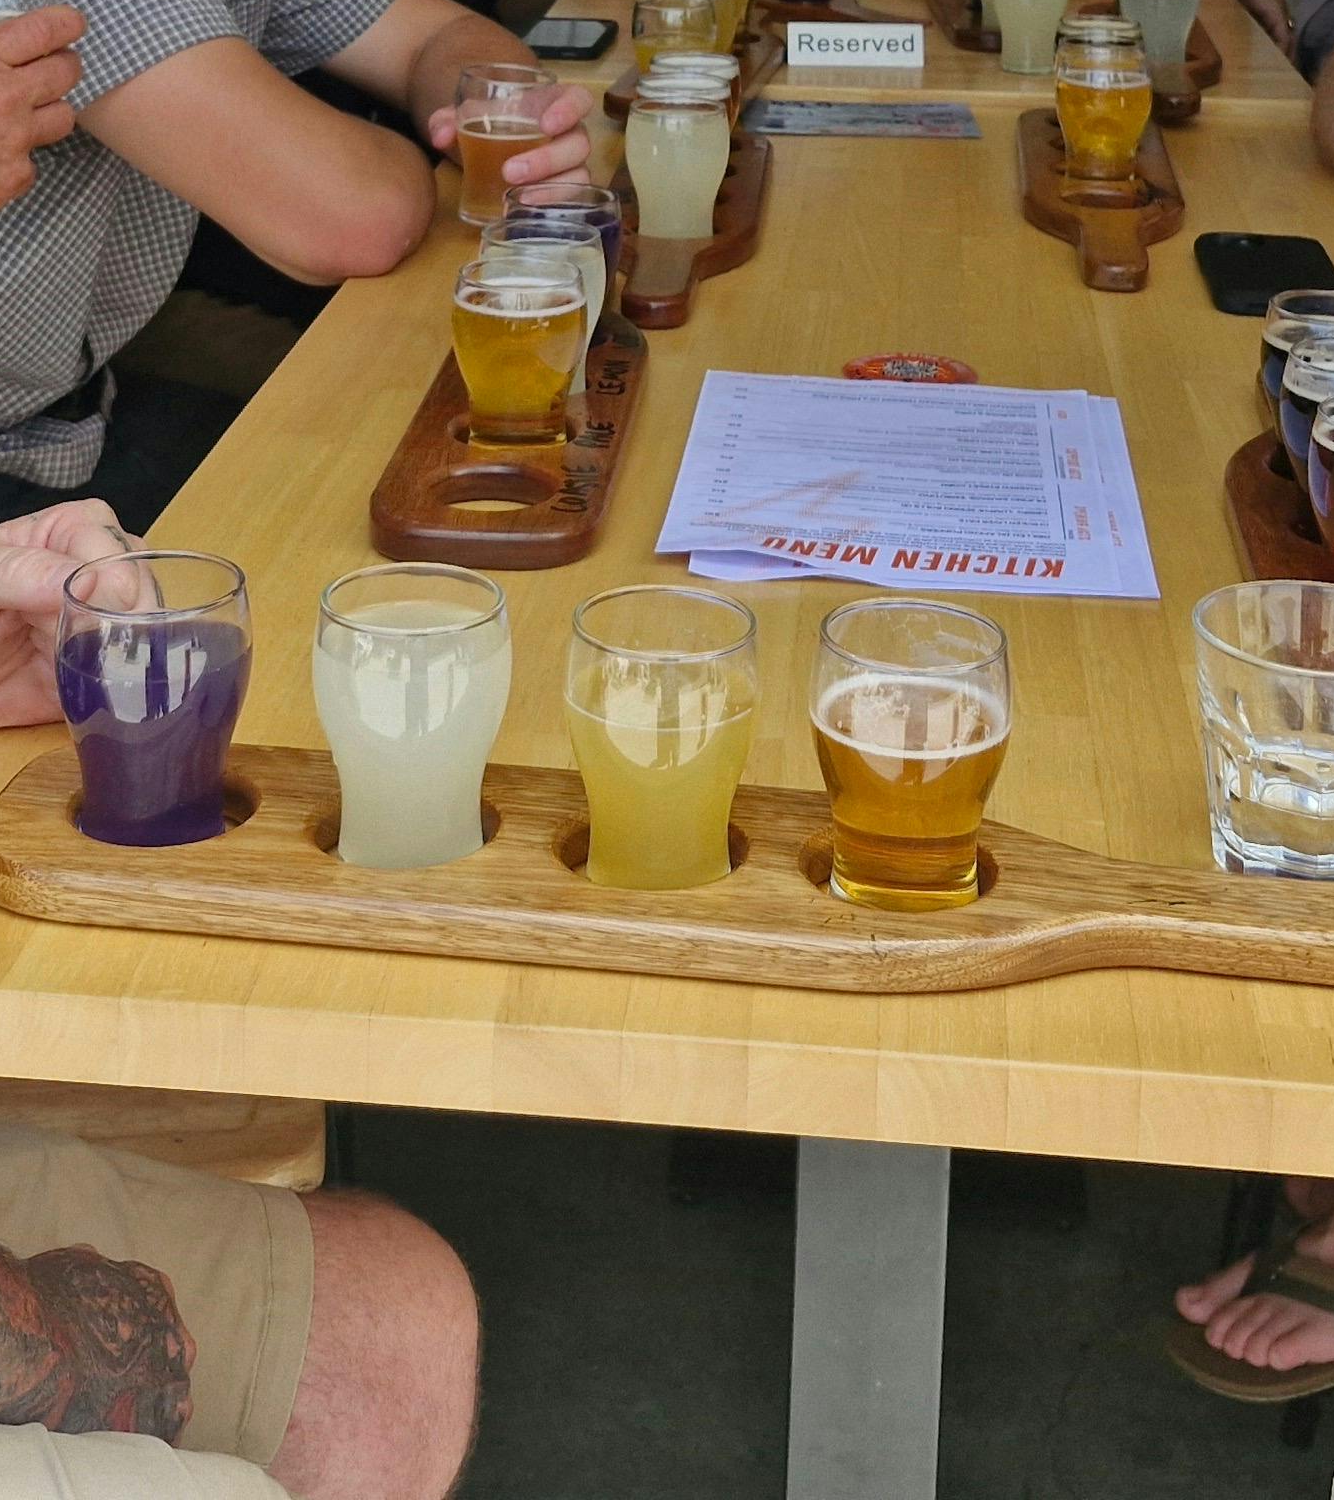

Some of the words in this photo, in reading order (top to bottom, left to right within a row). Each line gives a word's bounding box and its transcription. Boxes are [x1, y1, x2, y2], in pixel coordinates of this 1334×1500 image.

[798, 33, 915, 53] Reserved
[762, 537, 878, 564] MENU
[891, 548, 1066, 579] KITCHEN
